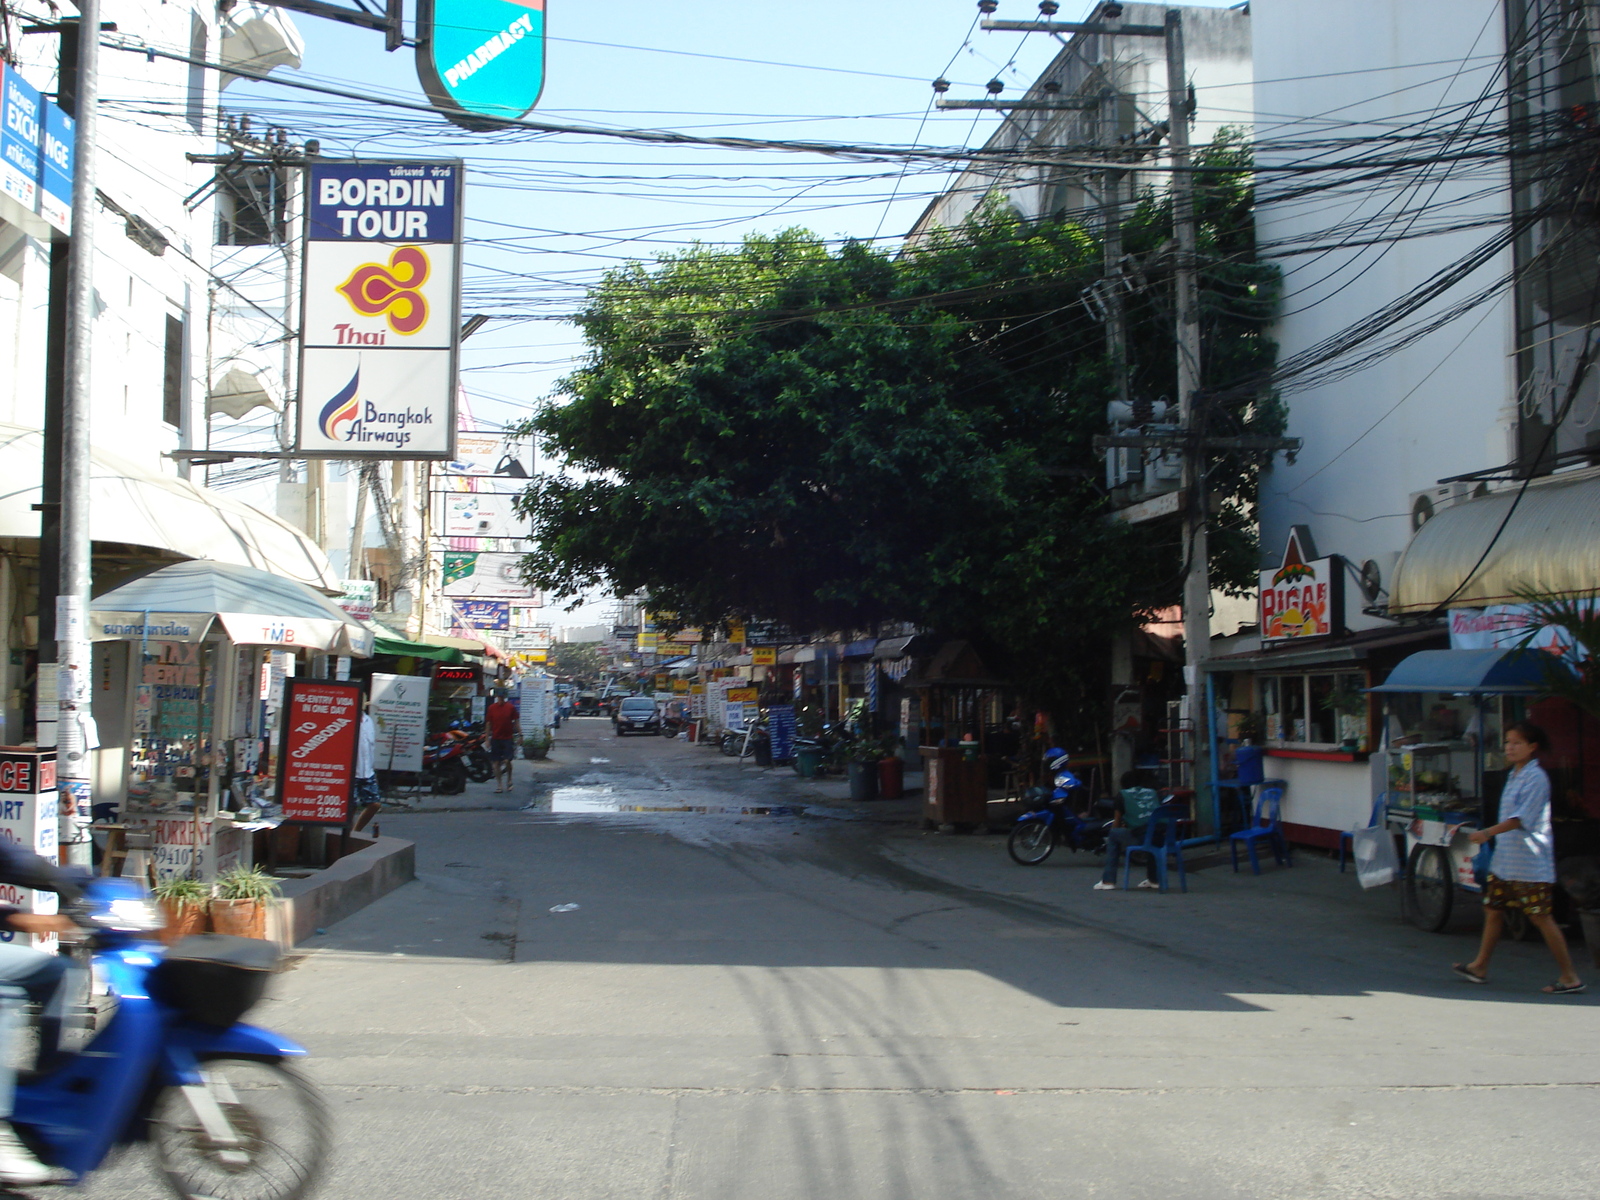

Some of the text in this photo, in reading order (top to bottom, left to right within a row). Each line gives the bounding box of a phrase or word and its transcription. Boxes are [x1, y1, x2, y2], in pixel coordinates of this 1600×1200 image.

[443, 13, 534, 88] PHARMACY
[7, 102, 70, 170] EXCHANGE
[319, 178, 445, 207] BORDIN
[336, 210, 428, 238] TOUR
[333, 324, 387, 345] Thai
[365, 400, 433, 429] Bangkok
[344, 419, 411, 448] Airways
[261, 624, 295, 642] TMB
[294, 694, 354, 706] RE-ENTRY VISA
[302, 704, 348, 715] IN ONE DAY
[291, 718, 352, 758] CAMBODIA
[294, 722, 317, 734] TO
[0, 800, 24, 820] RT
